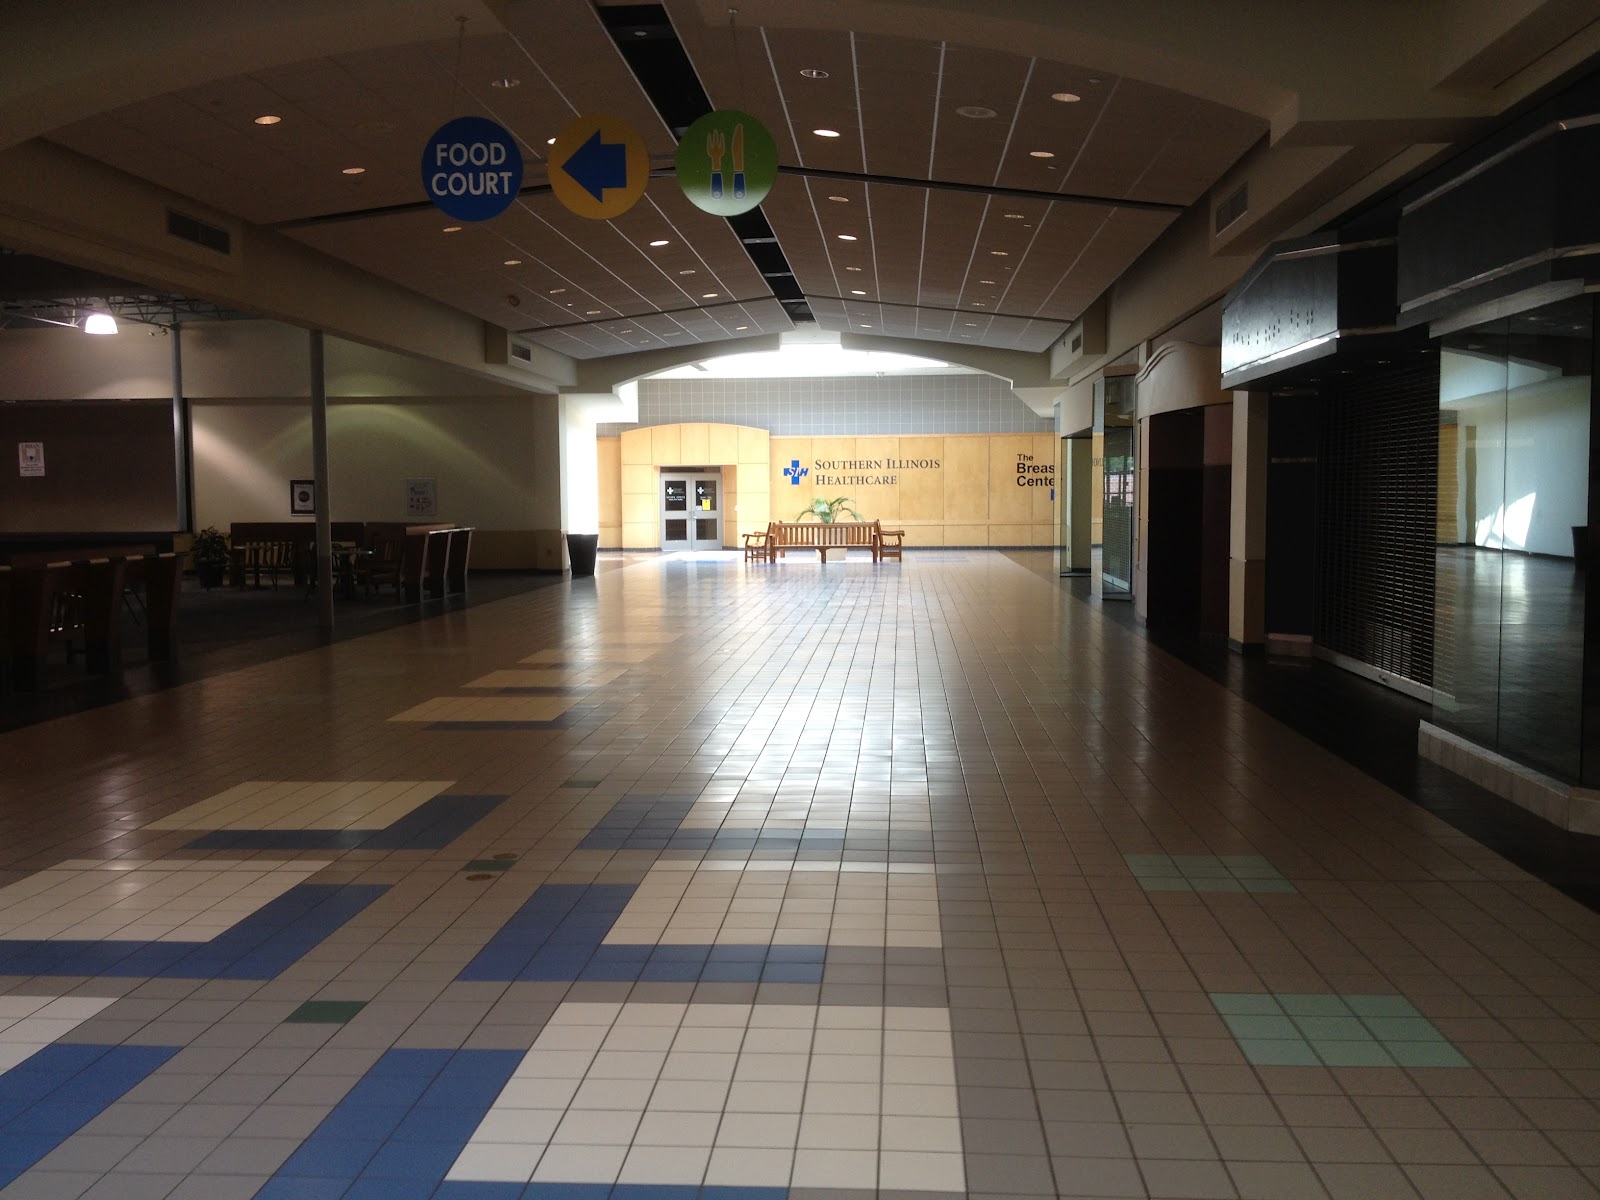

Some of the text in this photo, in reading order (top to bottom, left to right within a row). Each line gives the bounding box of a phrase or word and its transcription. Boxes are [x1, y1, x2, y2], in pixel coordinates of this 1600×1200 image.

[436, 142, 506, 167] FOOD
[431, 172, 512, 197] COURT
[1017, 453, 1034, 461] The
[815, 458, 941, 470] SOUTHERN ILLINOIS
[1017, 462, 1055, 474] Breas
[815, 475, 897, 486] HEALTHCARE
[1017, 475, 1055, 487] Cente
